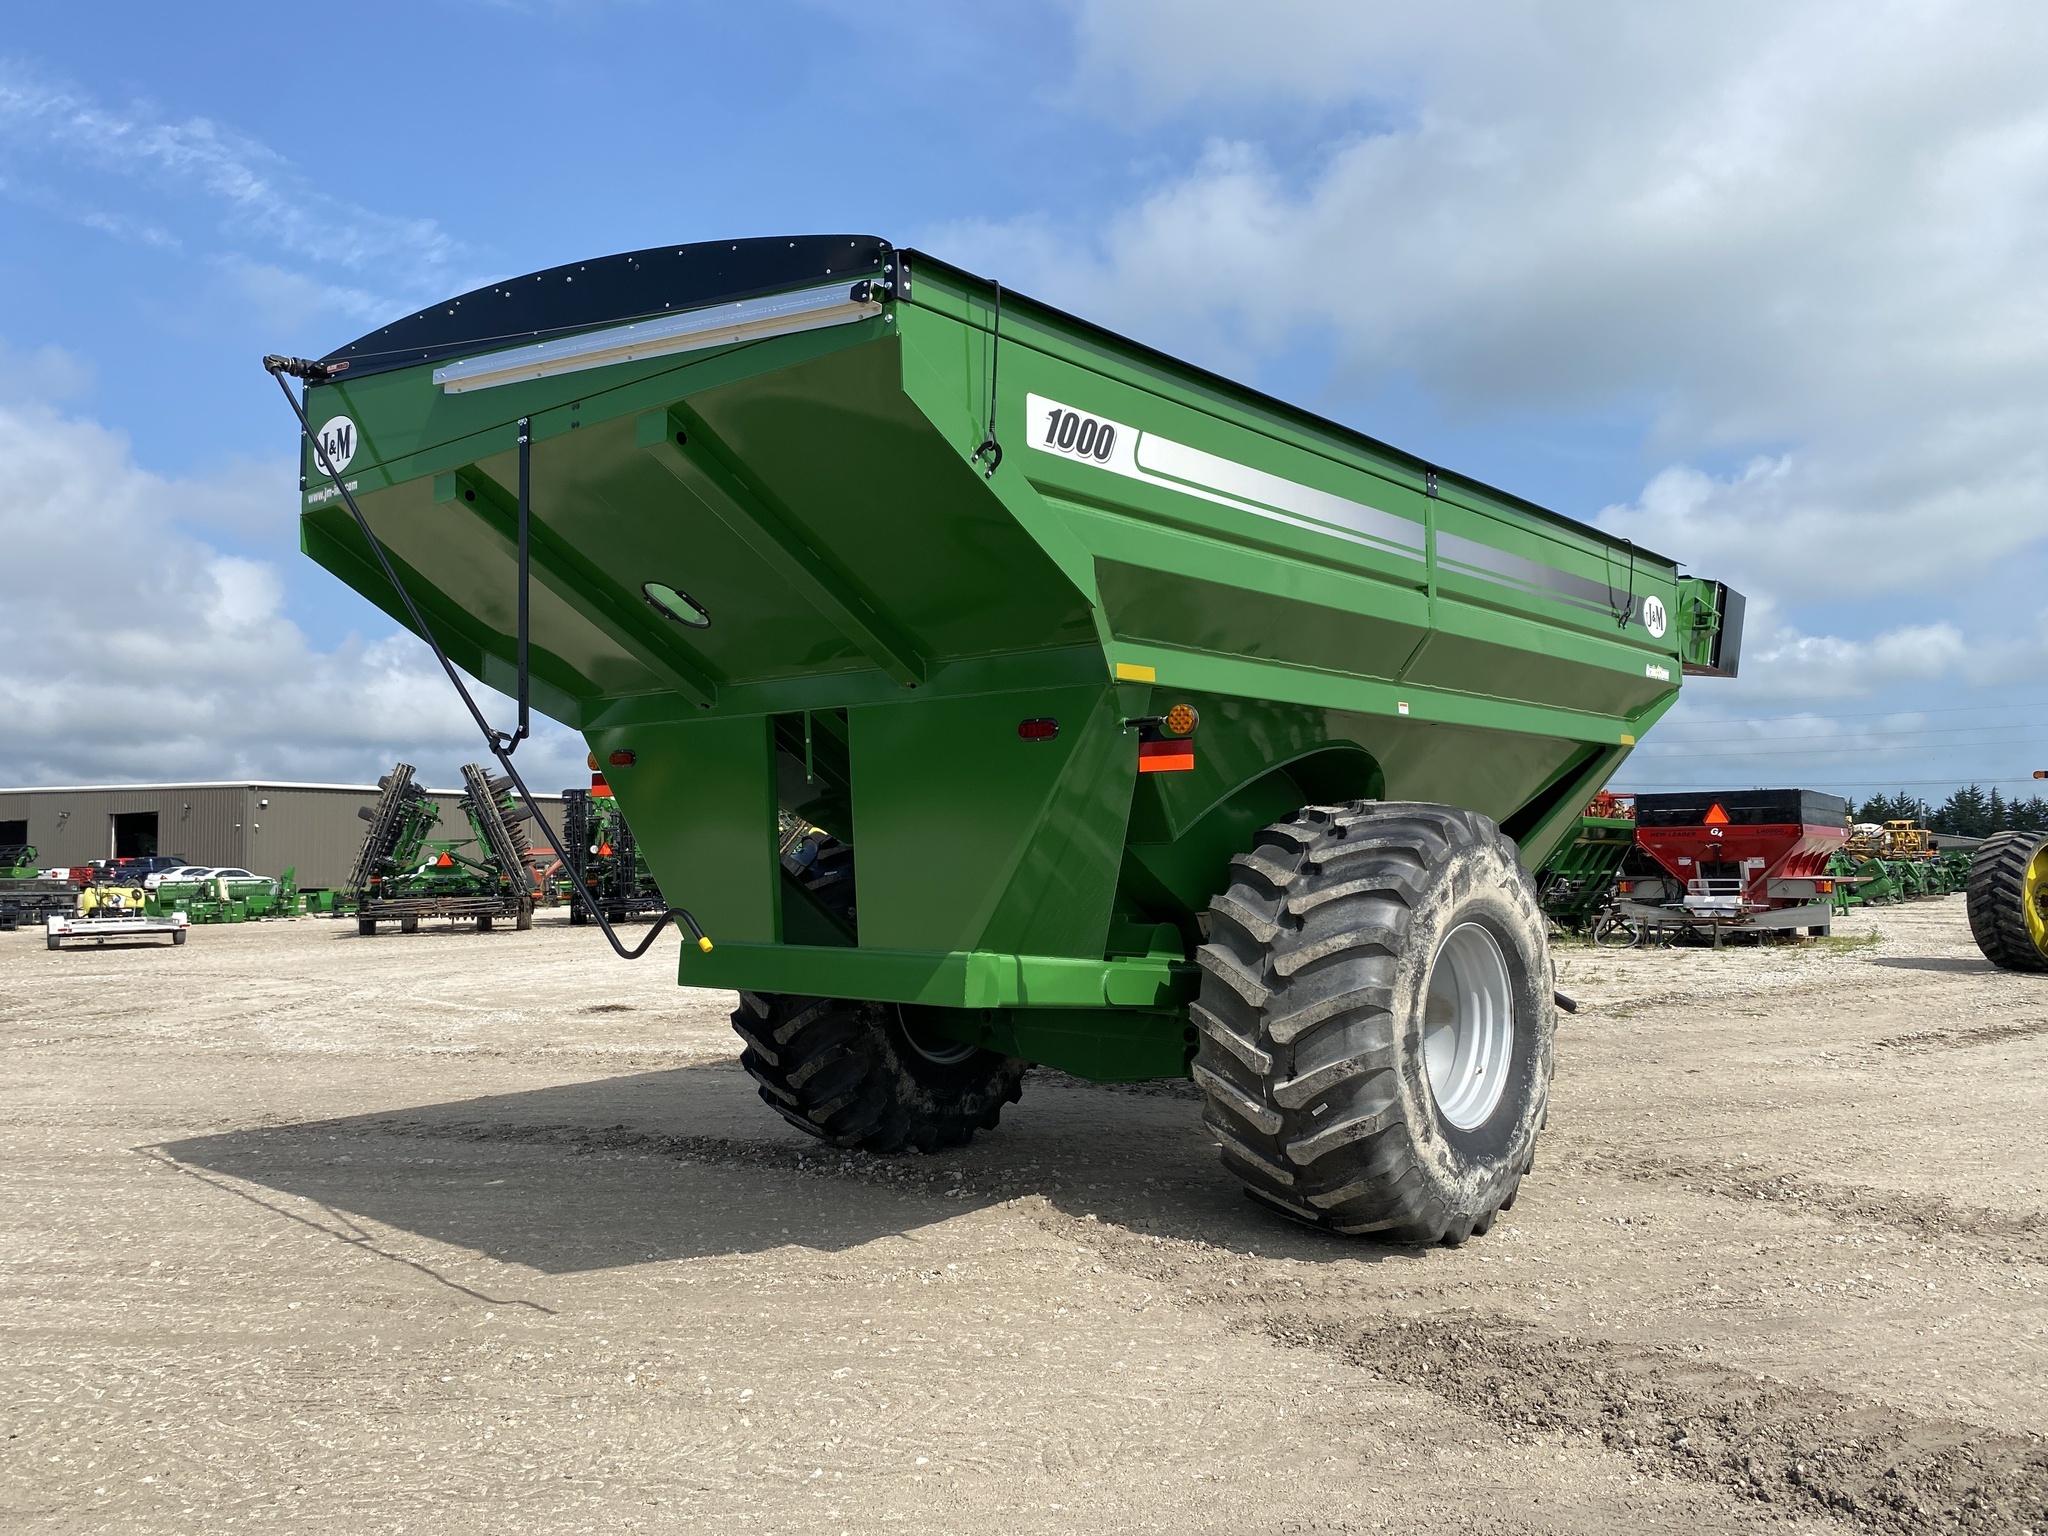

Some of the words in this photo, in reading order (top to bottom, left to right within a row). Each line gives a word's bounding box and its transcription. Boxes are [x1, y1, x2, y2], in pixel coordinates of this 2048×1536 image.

[317, 424, 352, 467] J&M
[1044, 408, 1117, 463] 1000
[1646, 603, 1664, 631] J&M
[1710, 827, 1723, 837] G4
